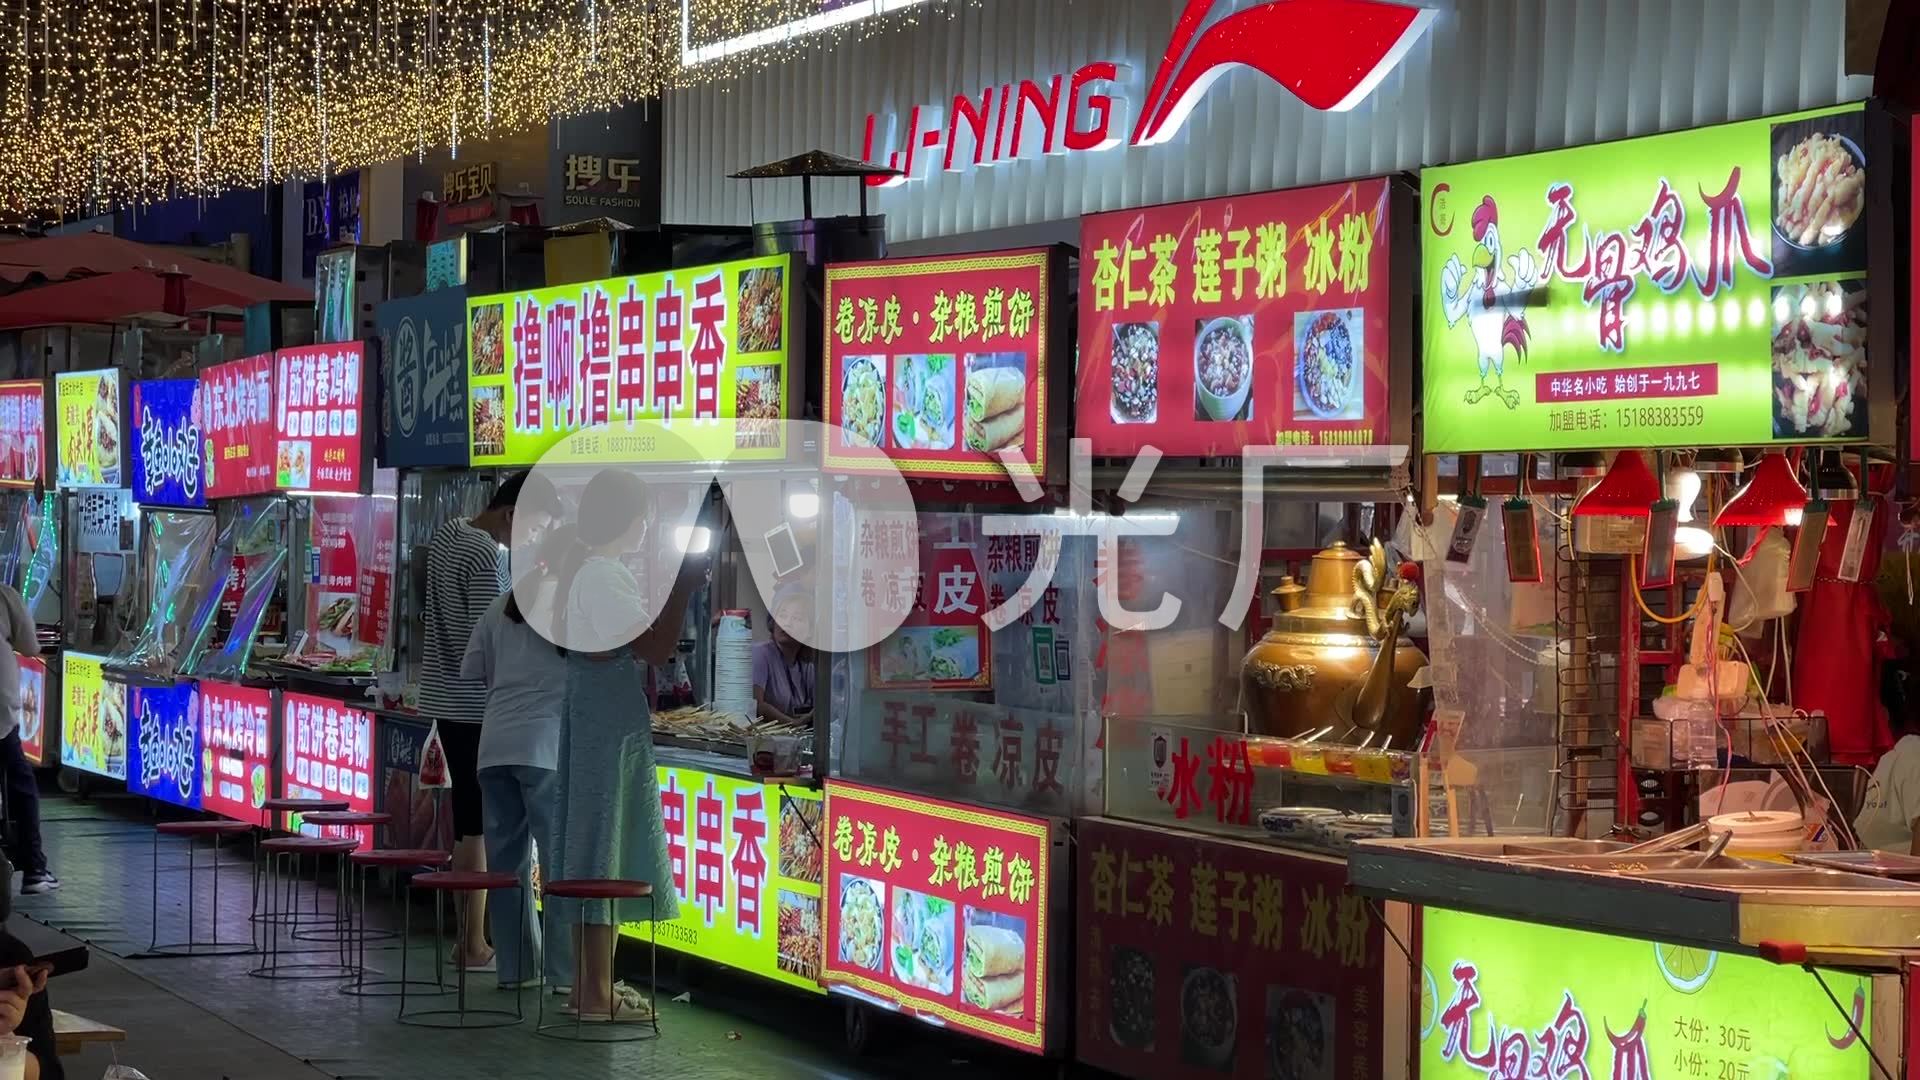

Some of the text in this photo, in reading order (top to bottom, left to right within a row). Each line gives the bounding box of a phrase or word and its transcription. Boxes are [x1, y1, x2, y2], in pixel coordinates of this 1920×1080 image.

[863, 61, 1118, 187] LI-NING
[566, 196, 641, 208] SOULE FASHION
[1091, 211, 1374, 312] 杏仁茶 莲子粥 冰粉
[1537, 166, 1774, 352] 无骨鸡爪
[213, 369, 270, 431] 东北烤冷面
[512, 272, 728, 432] 撸啊撸串串香
[1550, 373, 1702, 398] 中华名小吃 始创于一九九七
[212, 696, 268, 758] 东北烤冷面
[880, 700, 1064, 795] 手工卷凉皮
[1090, 843, 1370, 968] 杏仁茶 莲子粥 冰粉
